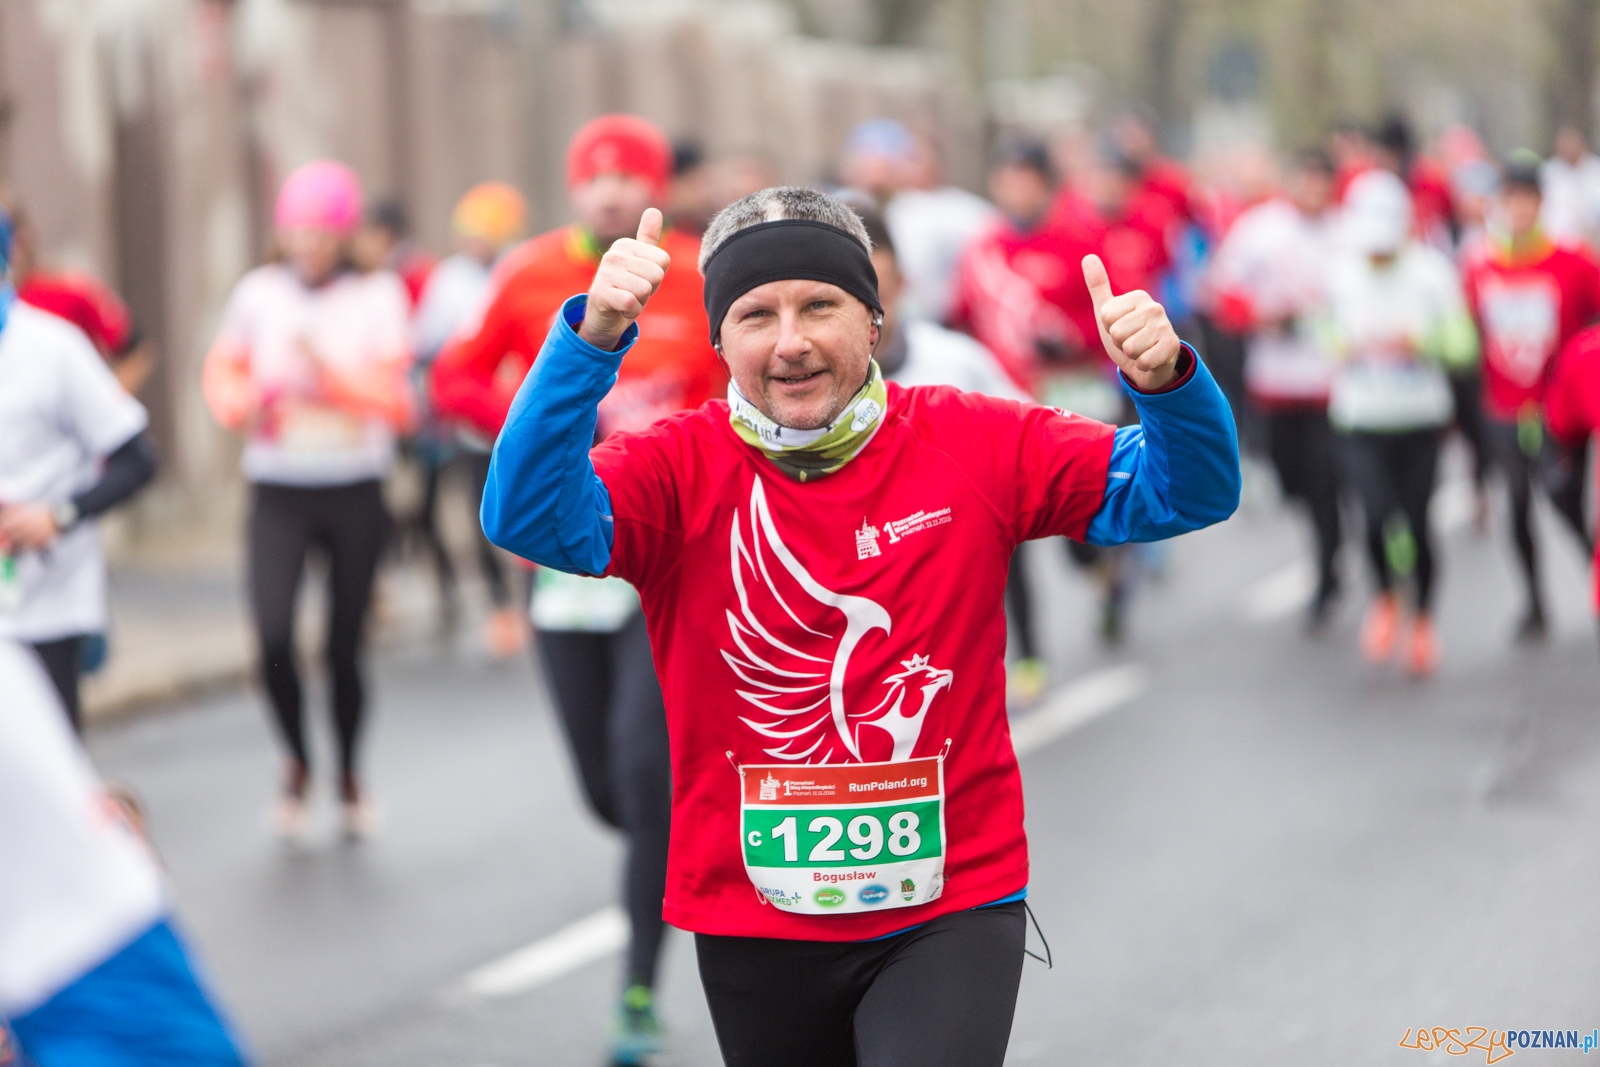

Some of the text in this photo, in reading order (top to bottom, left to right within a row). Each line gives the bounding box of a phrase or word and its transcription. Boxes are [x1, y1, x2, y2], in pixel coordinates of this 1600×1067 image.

[740, 404, 774, 429] FOREST
[883, 521, 901, 545] 1
[782, 780, 792, 796] 1
[848, 777, 928, 793] RunPoland.org
[771, 811, 922, 862] 1298
[812, 871, 877, 883] Bogusław
